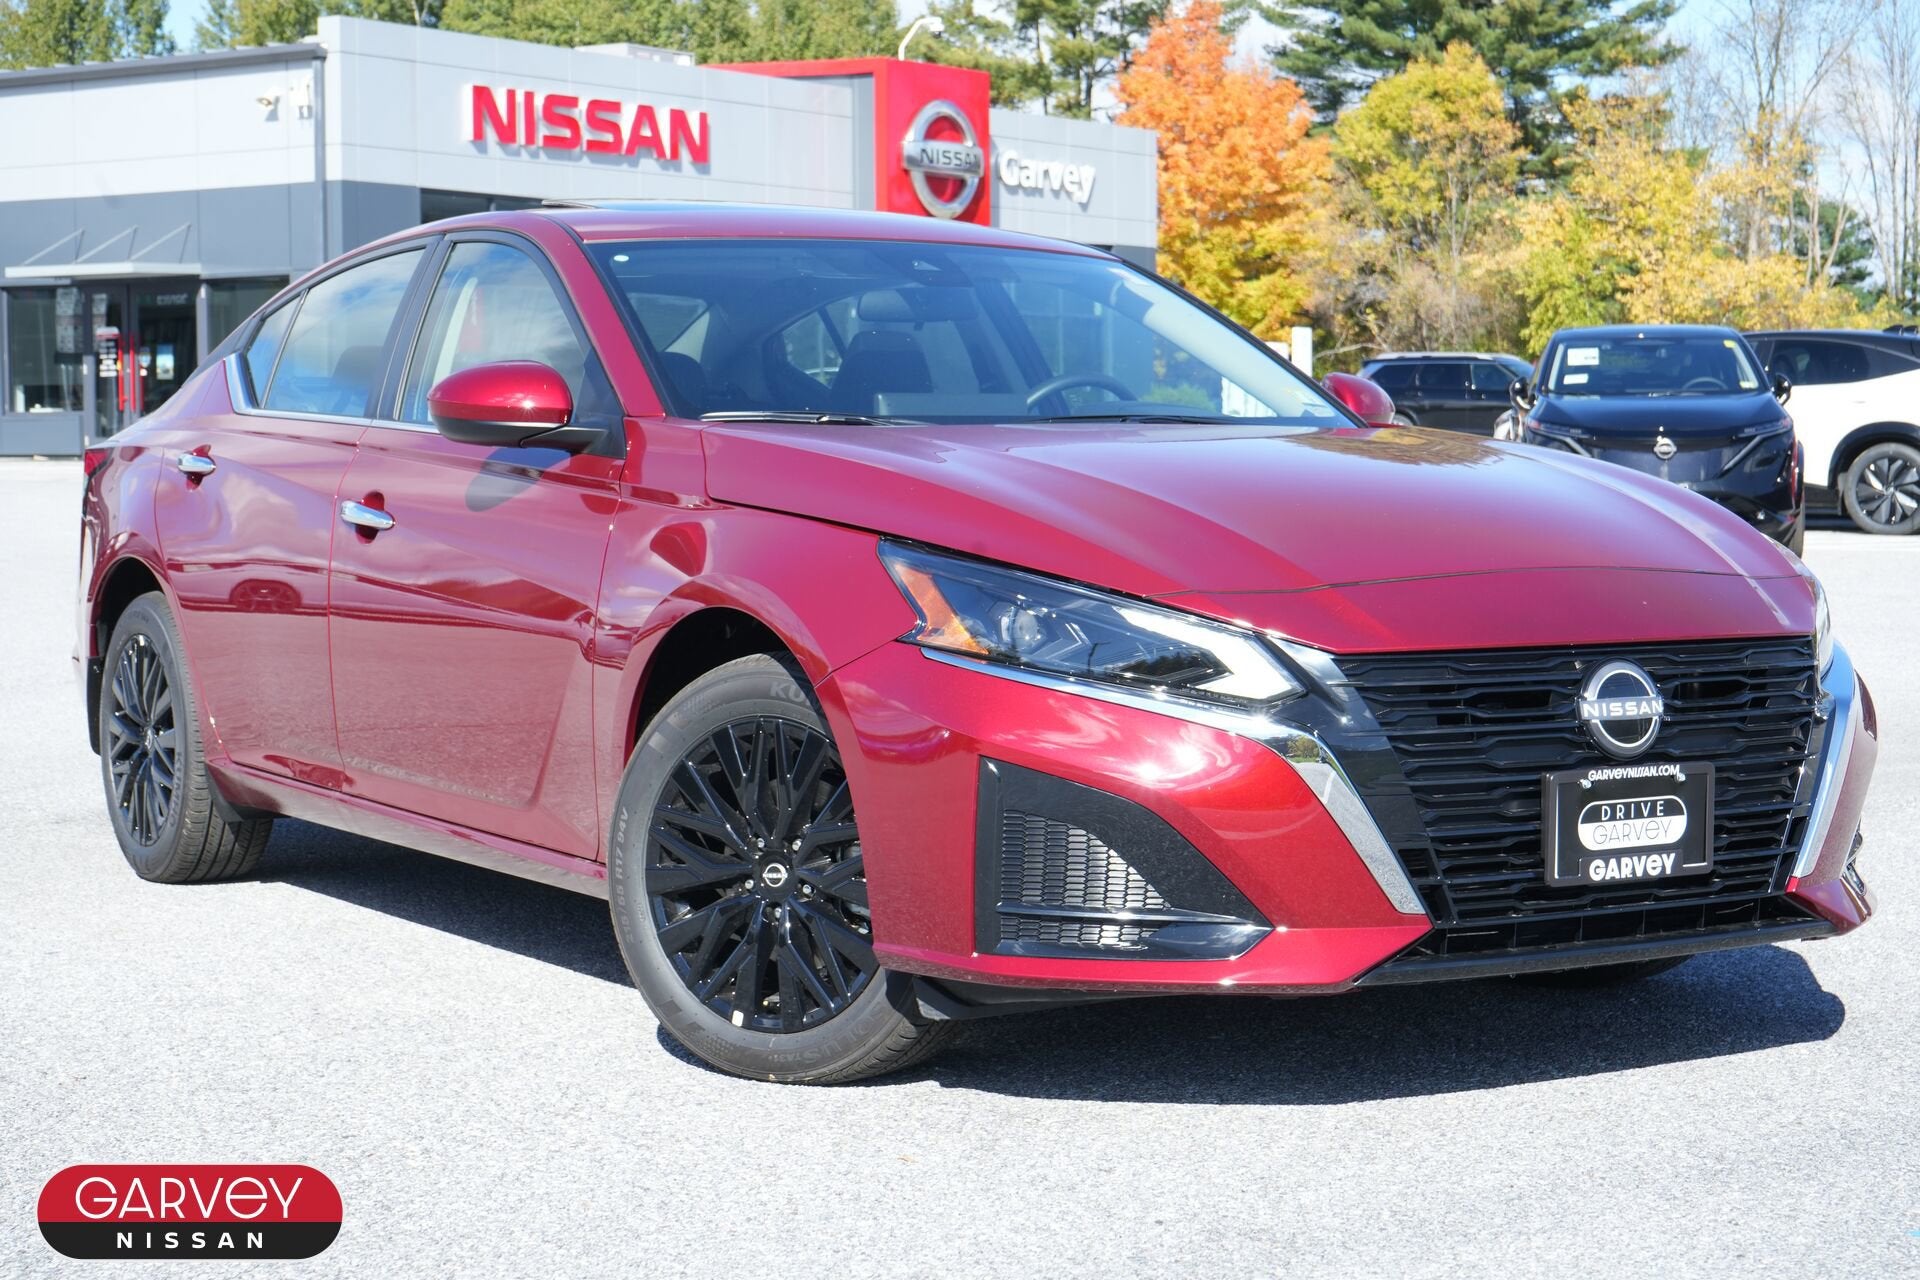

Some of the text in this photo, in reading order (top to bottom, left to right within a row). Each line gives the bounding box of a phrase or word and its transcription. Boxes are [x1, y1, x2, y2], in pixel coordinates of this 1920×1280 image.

[472, 84, 709, 165] NISSAN
[999, 150, 1096, 204] Garvey
[1582, 700, 1664, 718] NISSAN
[1601, 800, 1665, 821] DRIVE
